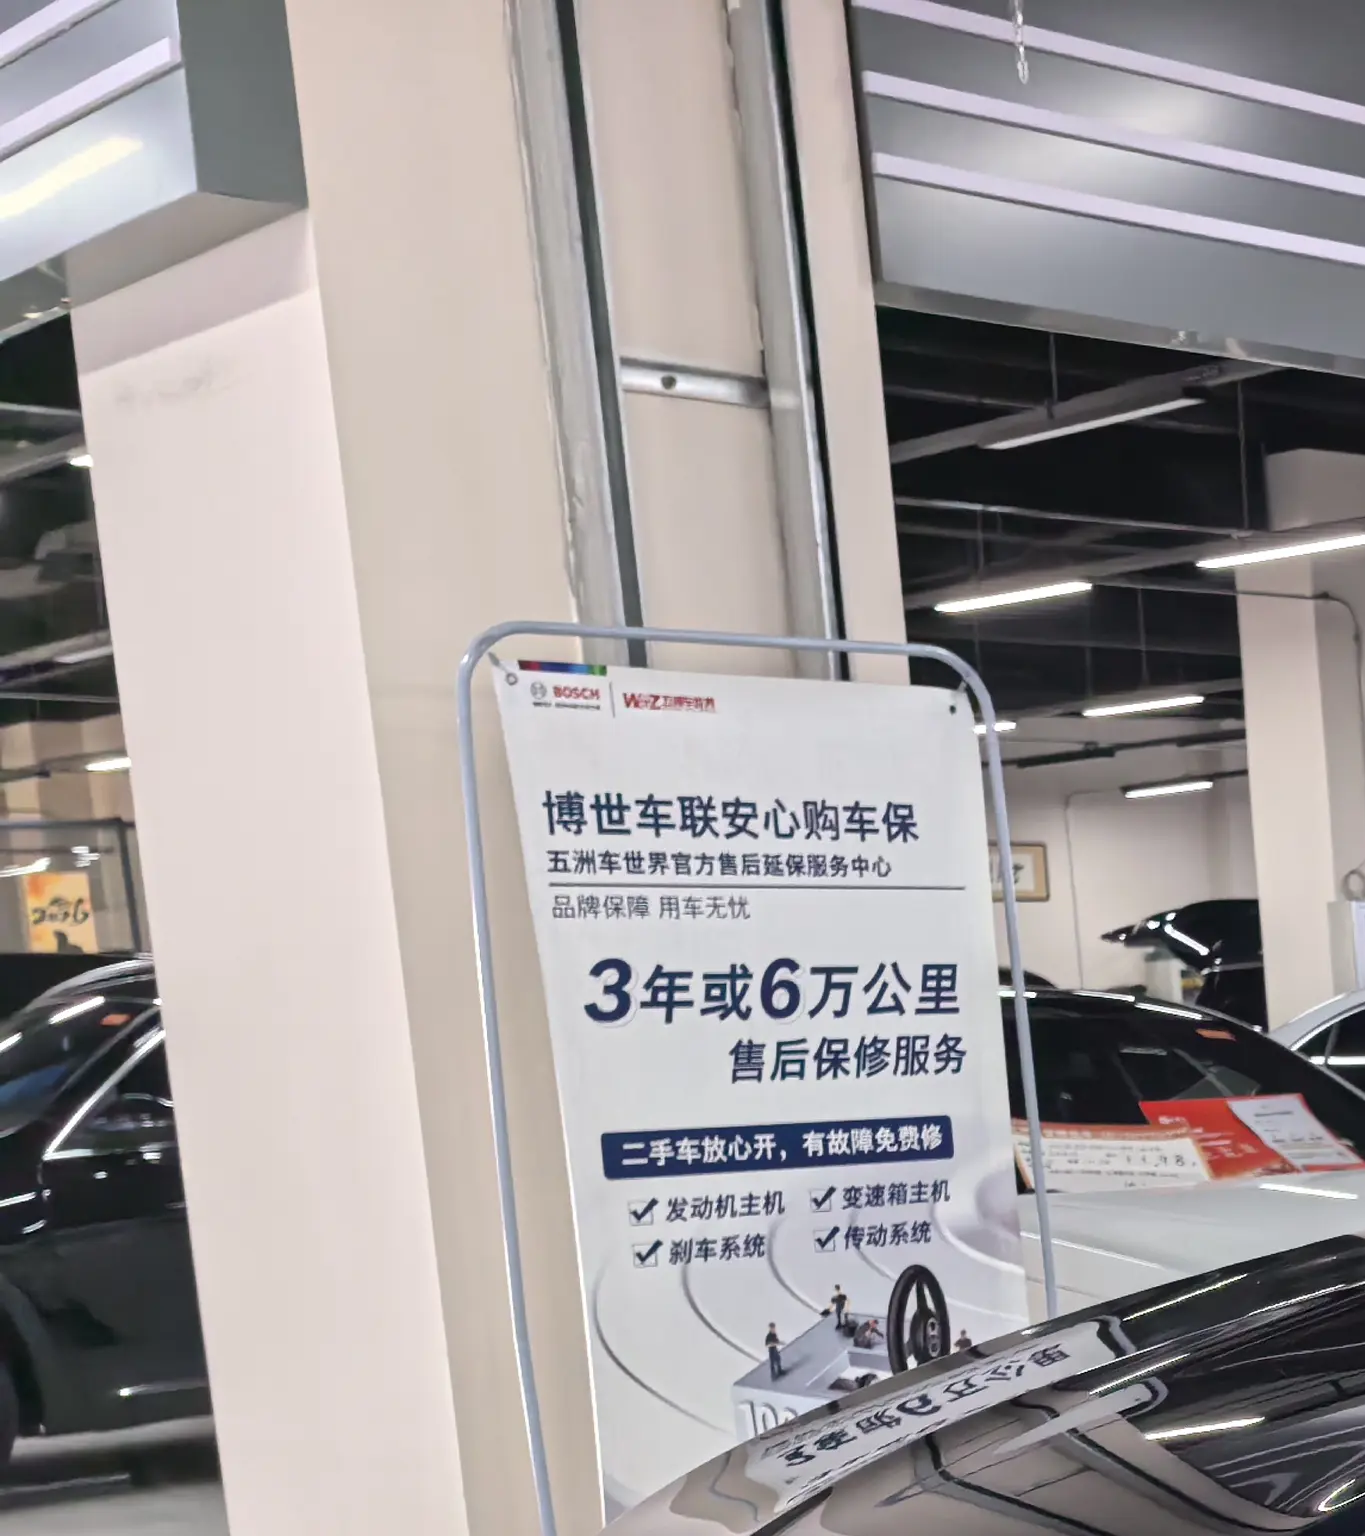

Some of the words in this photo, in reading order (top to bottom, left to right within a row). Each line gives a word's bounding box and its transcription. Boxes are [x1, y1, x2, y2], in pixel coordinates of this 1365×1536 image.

[552, 685, 601, 700] BOSCH
[541, 790, 920, 844] 博世车联安心购车保
[545, 847, 893, 879] 五洲车世界官方售后延保服务中心
[552, 894, 650, 920] 品牌保障
[658, 895, 751, 920] 用车无忧
[583, 957, 961, 1024] 3年或6万公里
[728, 1032, 968, 1085] 售后保修服务
[665, 1190, 785, 1223] 发动机主机
[840, 1179, 951, 1211] 变速箱主机
[668, 1233, 767, 1266] 刹车系统
[843, 1219, 932, 1251] 传动系统
